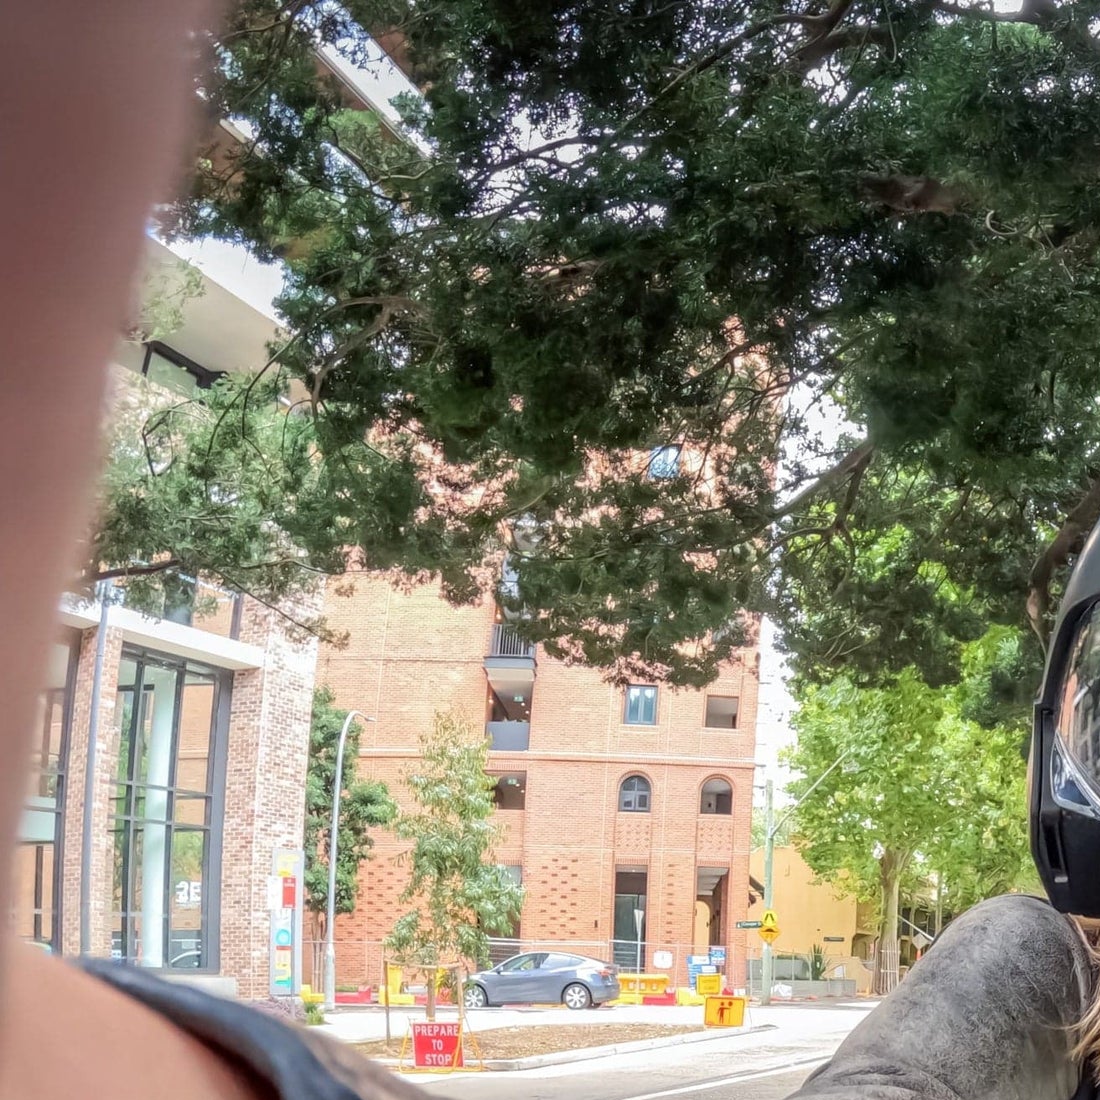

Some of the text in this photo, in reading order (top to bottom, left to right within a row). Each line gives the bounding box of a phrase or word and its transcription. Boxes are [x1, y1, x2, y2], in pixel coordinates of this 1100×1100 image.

[414, 1025, 459, 1037] PREPARE
[431, 1039, 443, 1051] TO
[424, 1053, 451, 1066] STOP
